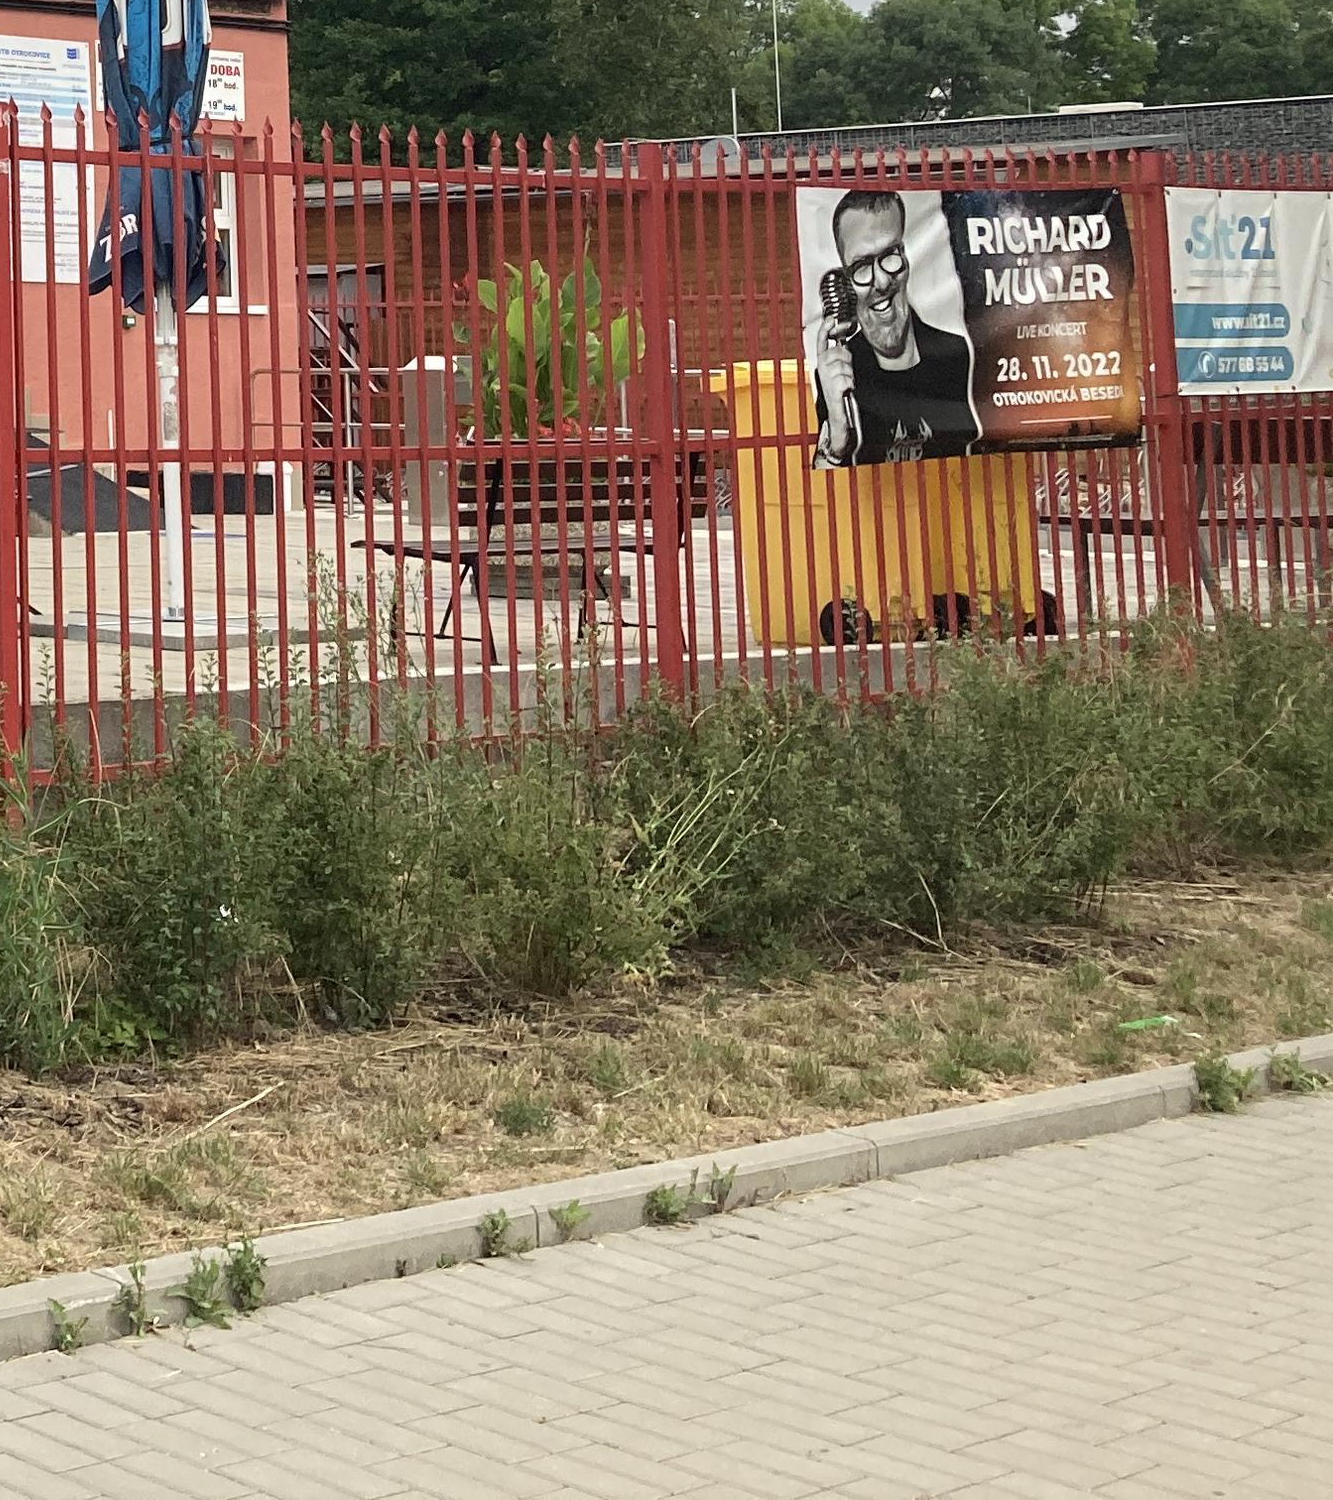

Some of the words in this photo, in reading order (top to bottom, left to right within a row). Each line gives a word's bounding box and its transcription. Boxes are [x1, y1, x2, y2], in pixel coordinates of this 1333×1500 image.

[210, 64, 240, 76] DOBA
[967, 214, 1112, 255] RICHARD
[984, 257, 1114, 306] MÜLLER
[1017, 324, 1037, 340] LIVE
[1038, 321, 1088, 338] KONCERT
[997, 357, 1028, 382] 28.
[1031, 355, 1059, 380] 11.
[1063, 350, 1121, 378] 2022
[993, 385, 1079, 407] OTROKOVICKÁ
